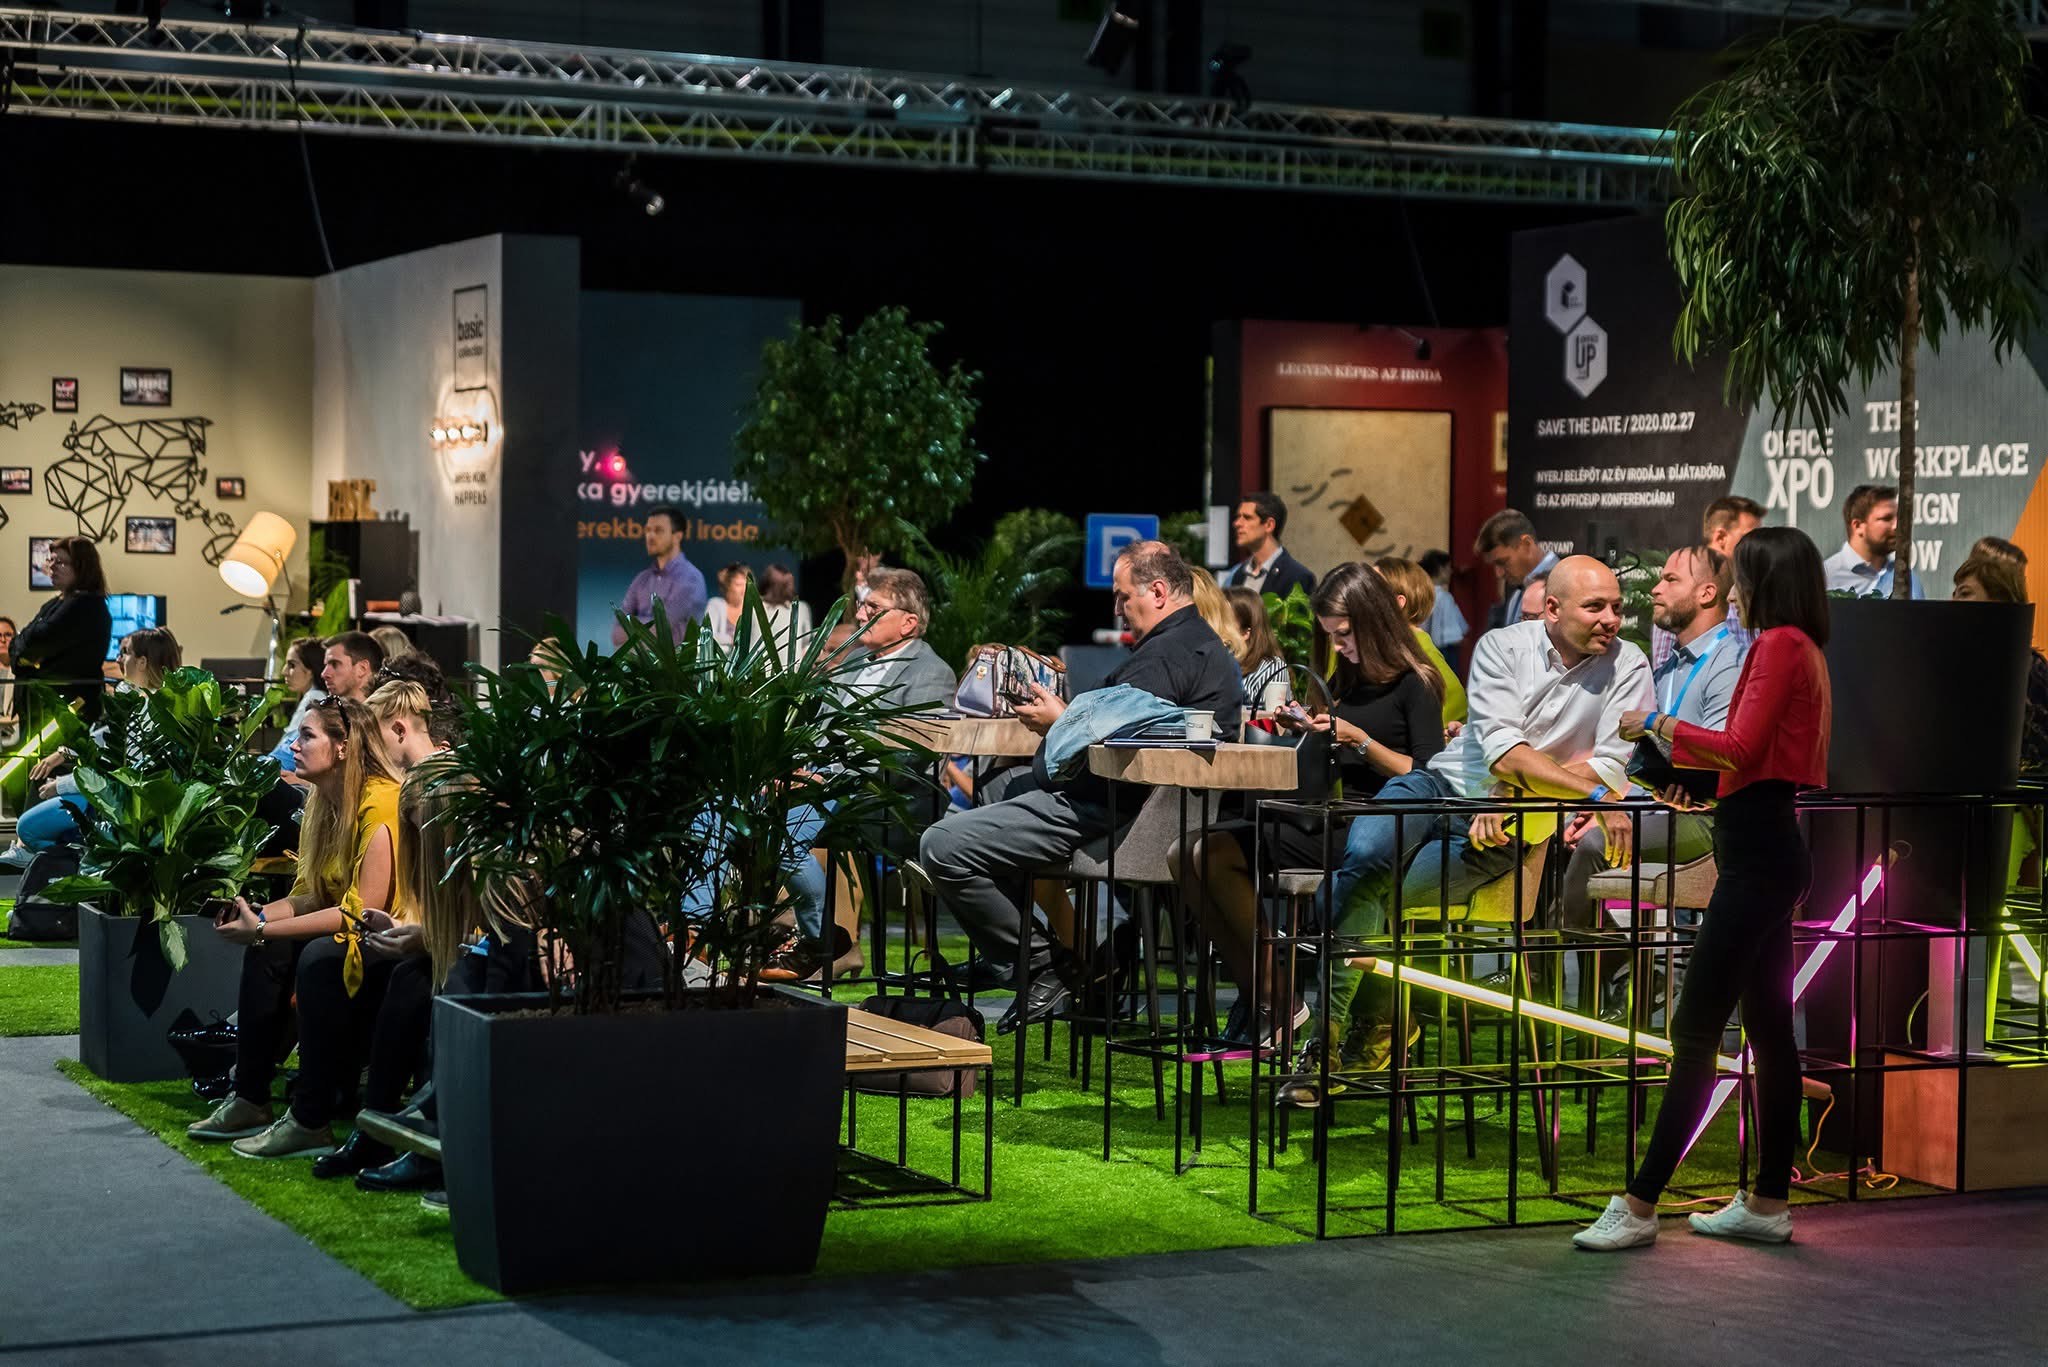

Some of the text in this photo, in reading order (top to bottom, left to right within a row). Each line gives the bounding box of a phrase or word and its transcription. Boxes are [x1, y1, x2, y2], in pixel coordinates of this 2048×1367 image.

[457, 313, 484, 341] basic
[1537, 419, 1566, 436] SAVE
[1568, 417, 1590, 434] THE
[1591, 415, 1621, 434] DATE
[1630, 411, 1695, 433] 2020.02.27
[1766, 457, 1835, 528] XPO
[1101, 526, 1142, 576] P
